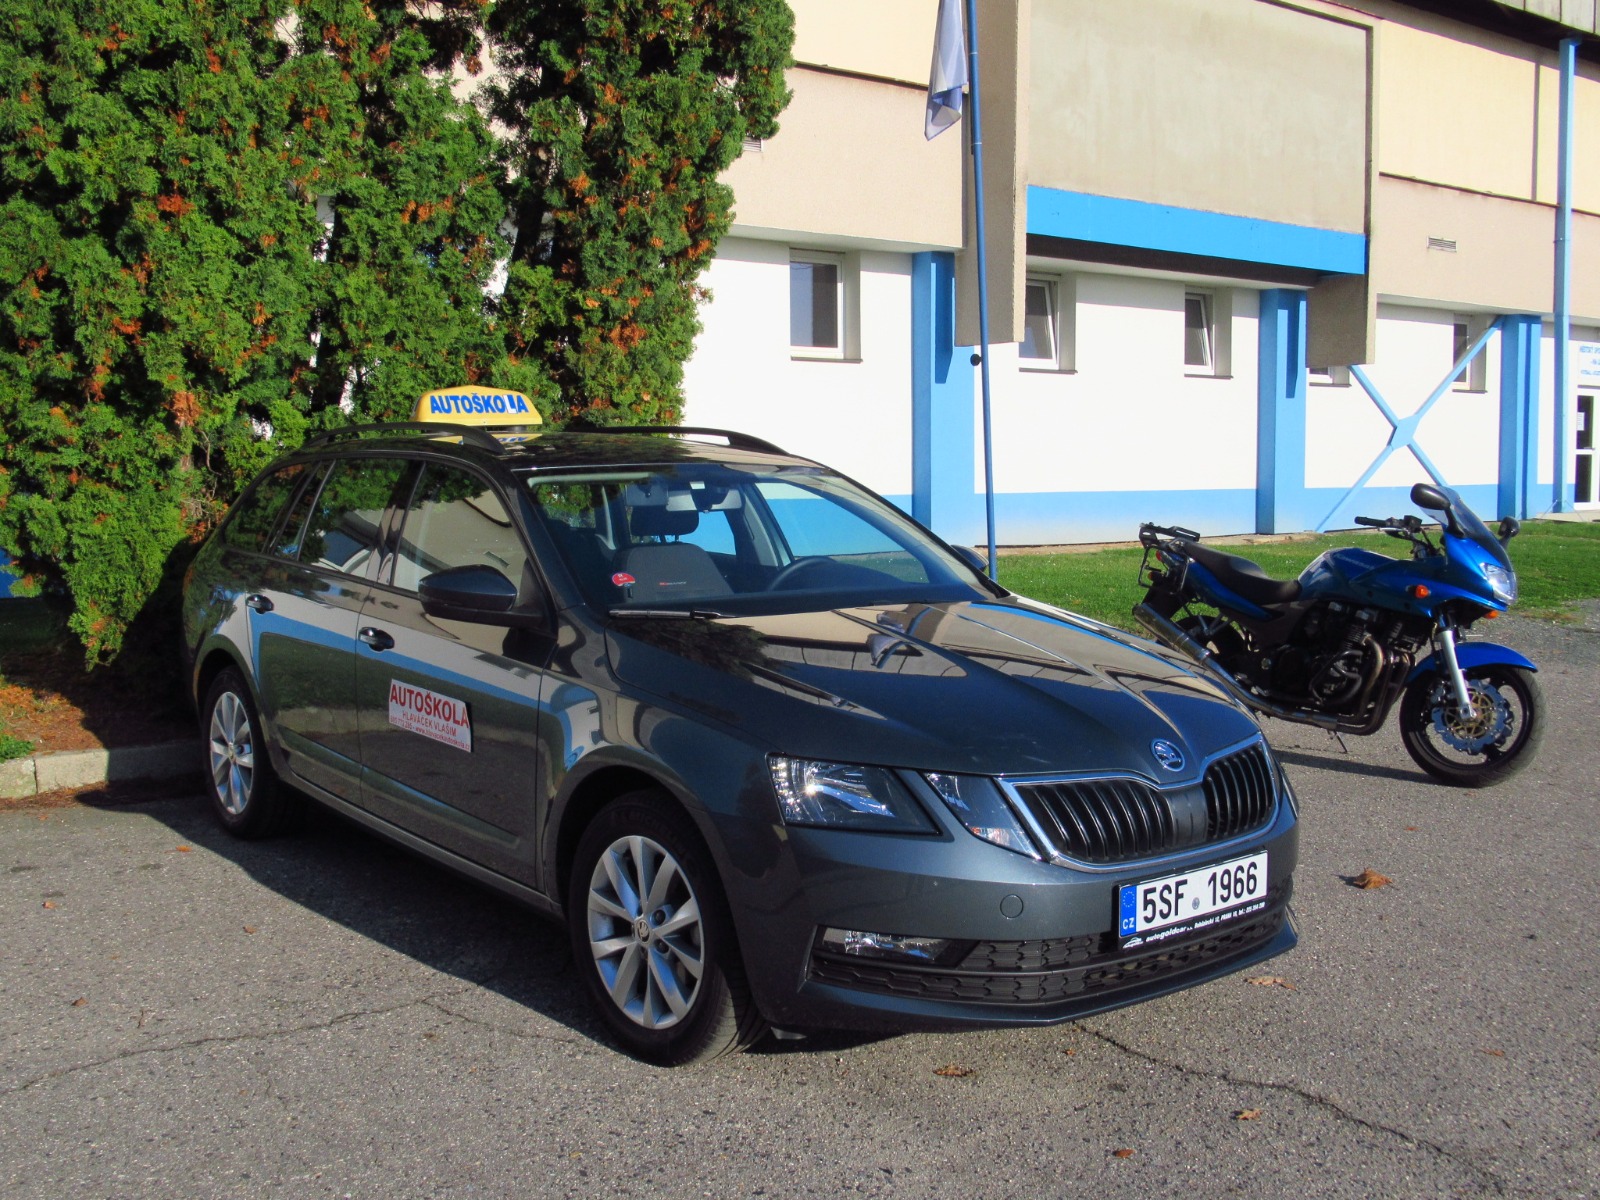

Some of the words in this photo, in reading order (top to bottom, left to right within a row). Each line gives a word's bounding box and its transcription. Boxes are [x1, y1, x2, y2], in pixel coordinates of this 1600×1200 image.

[429, 392, 529, 415] AUTOŠKOLA
[390, 684, 469, 729] AUTOŠKOLA
[1143, 878, 1188, 924] 5SF
[1207, 861, 1258, 906] 1966
[1122, 916, 1135, 930] CZ
